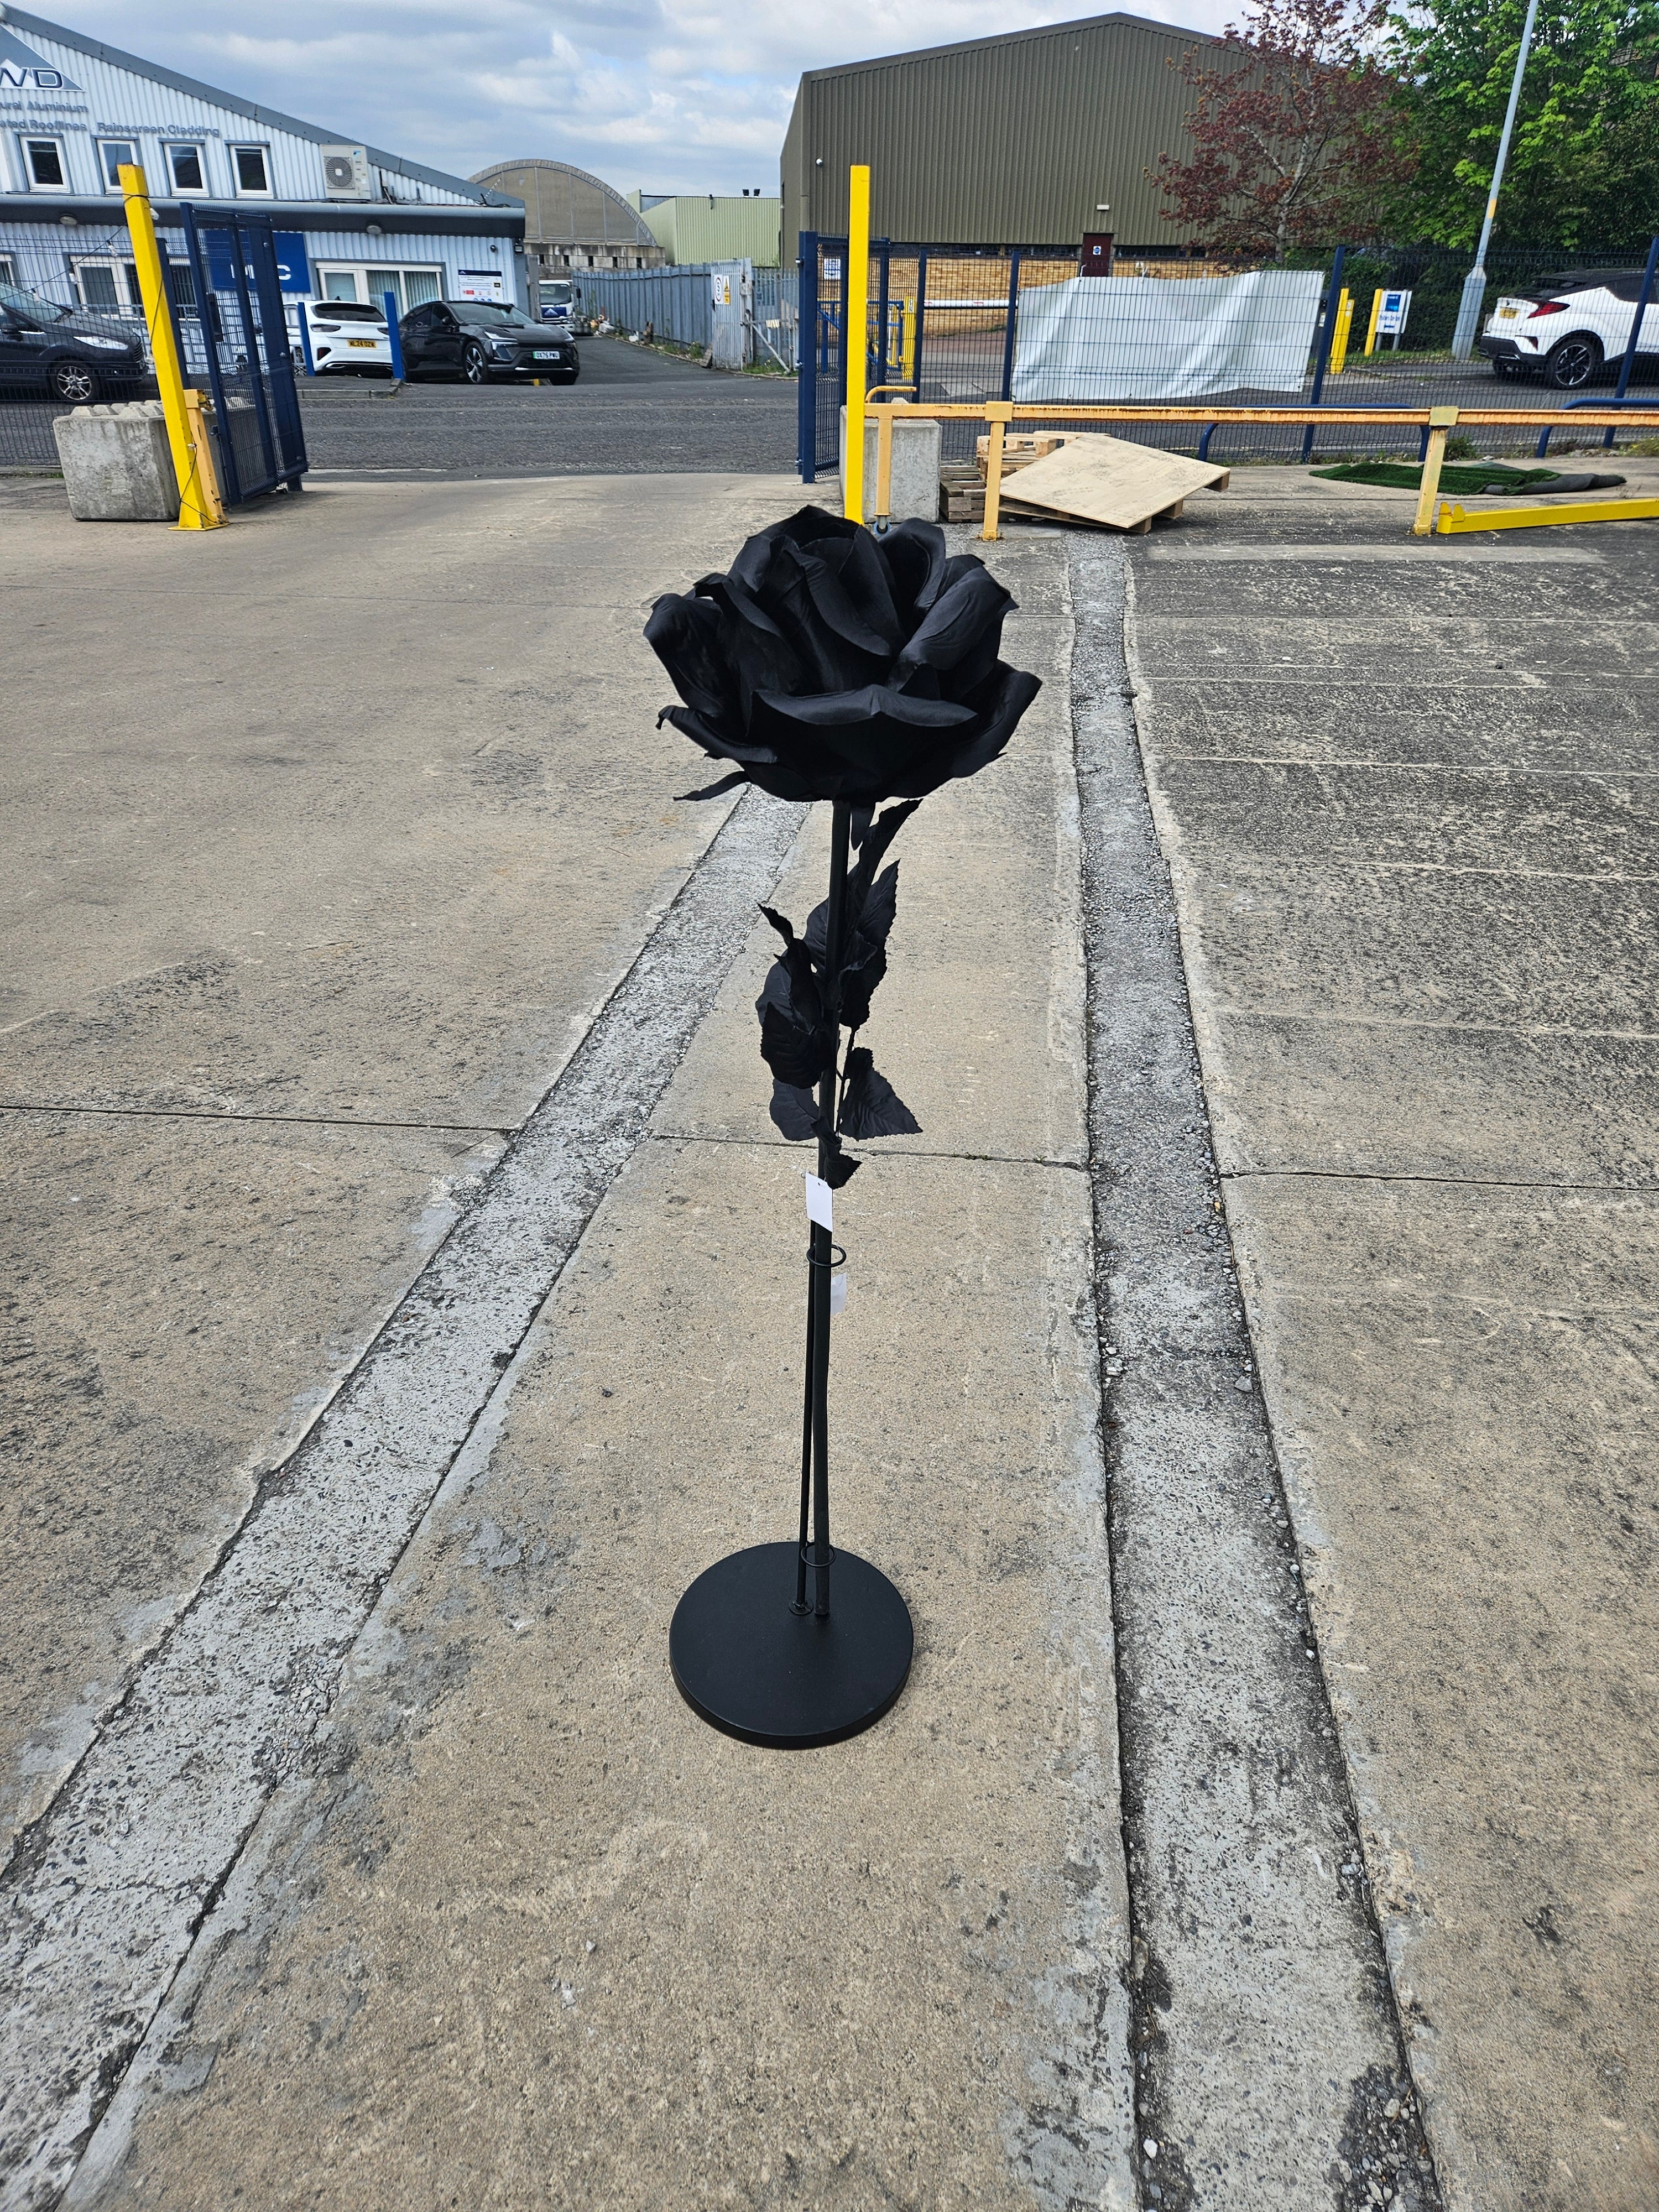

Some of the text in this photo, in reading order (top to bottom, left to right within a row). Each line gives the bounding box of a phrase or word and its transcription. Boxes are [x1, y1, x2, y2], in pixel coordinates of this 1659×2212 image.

[27, 101, 89, 112] Aluminium
[97, 122, 165, 134] Rainscreen
[168, 124, 220, 138] Cladding
